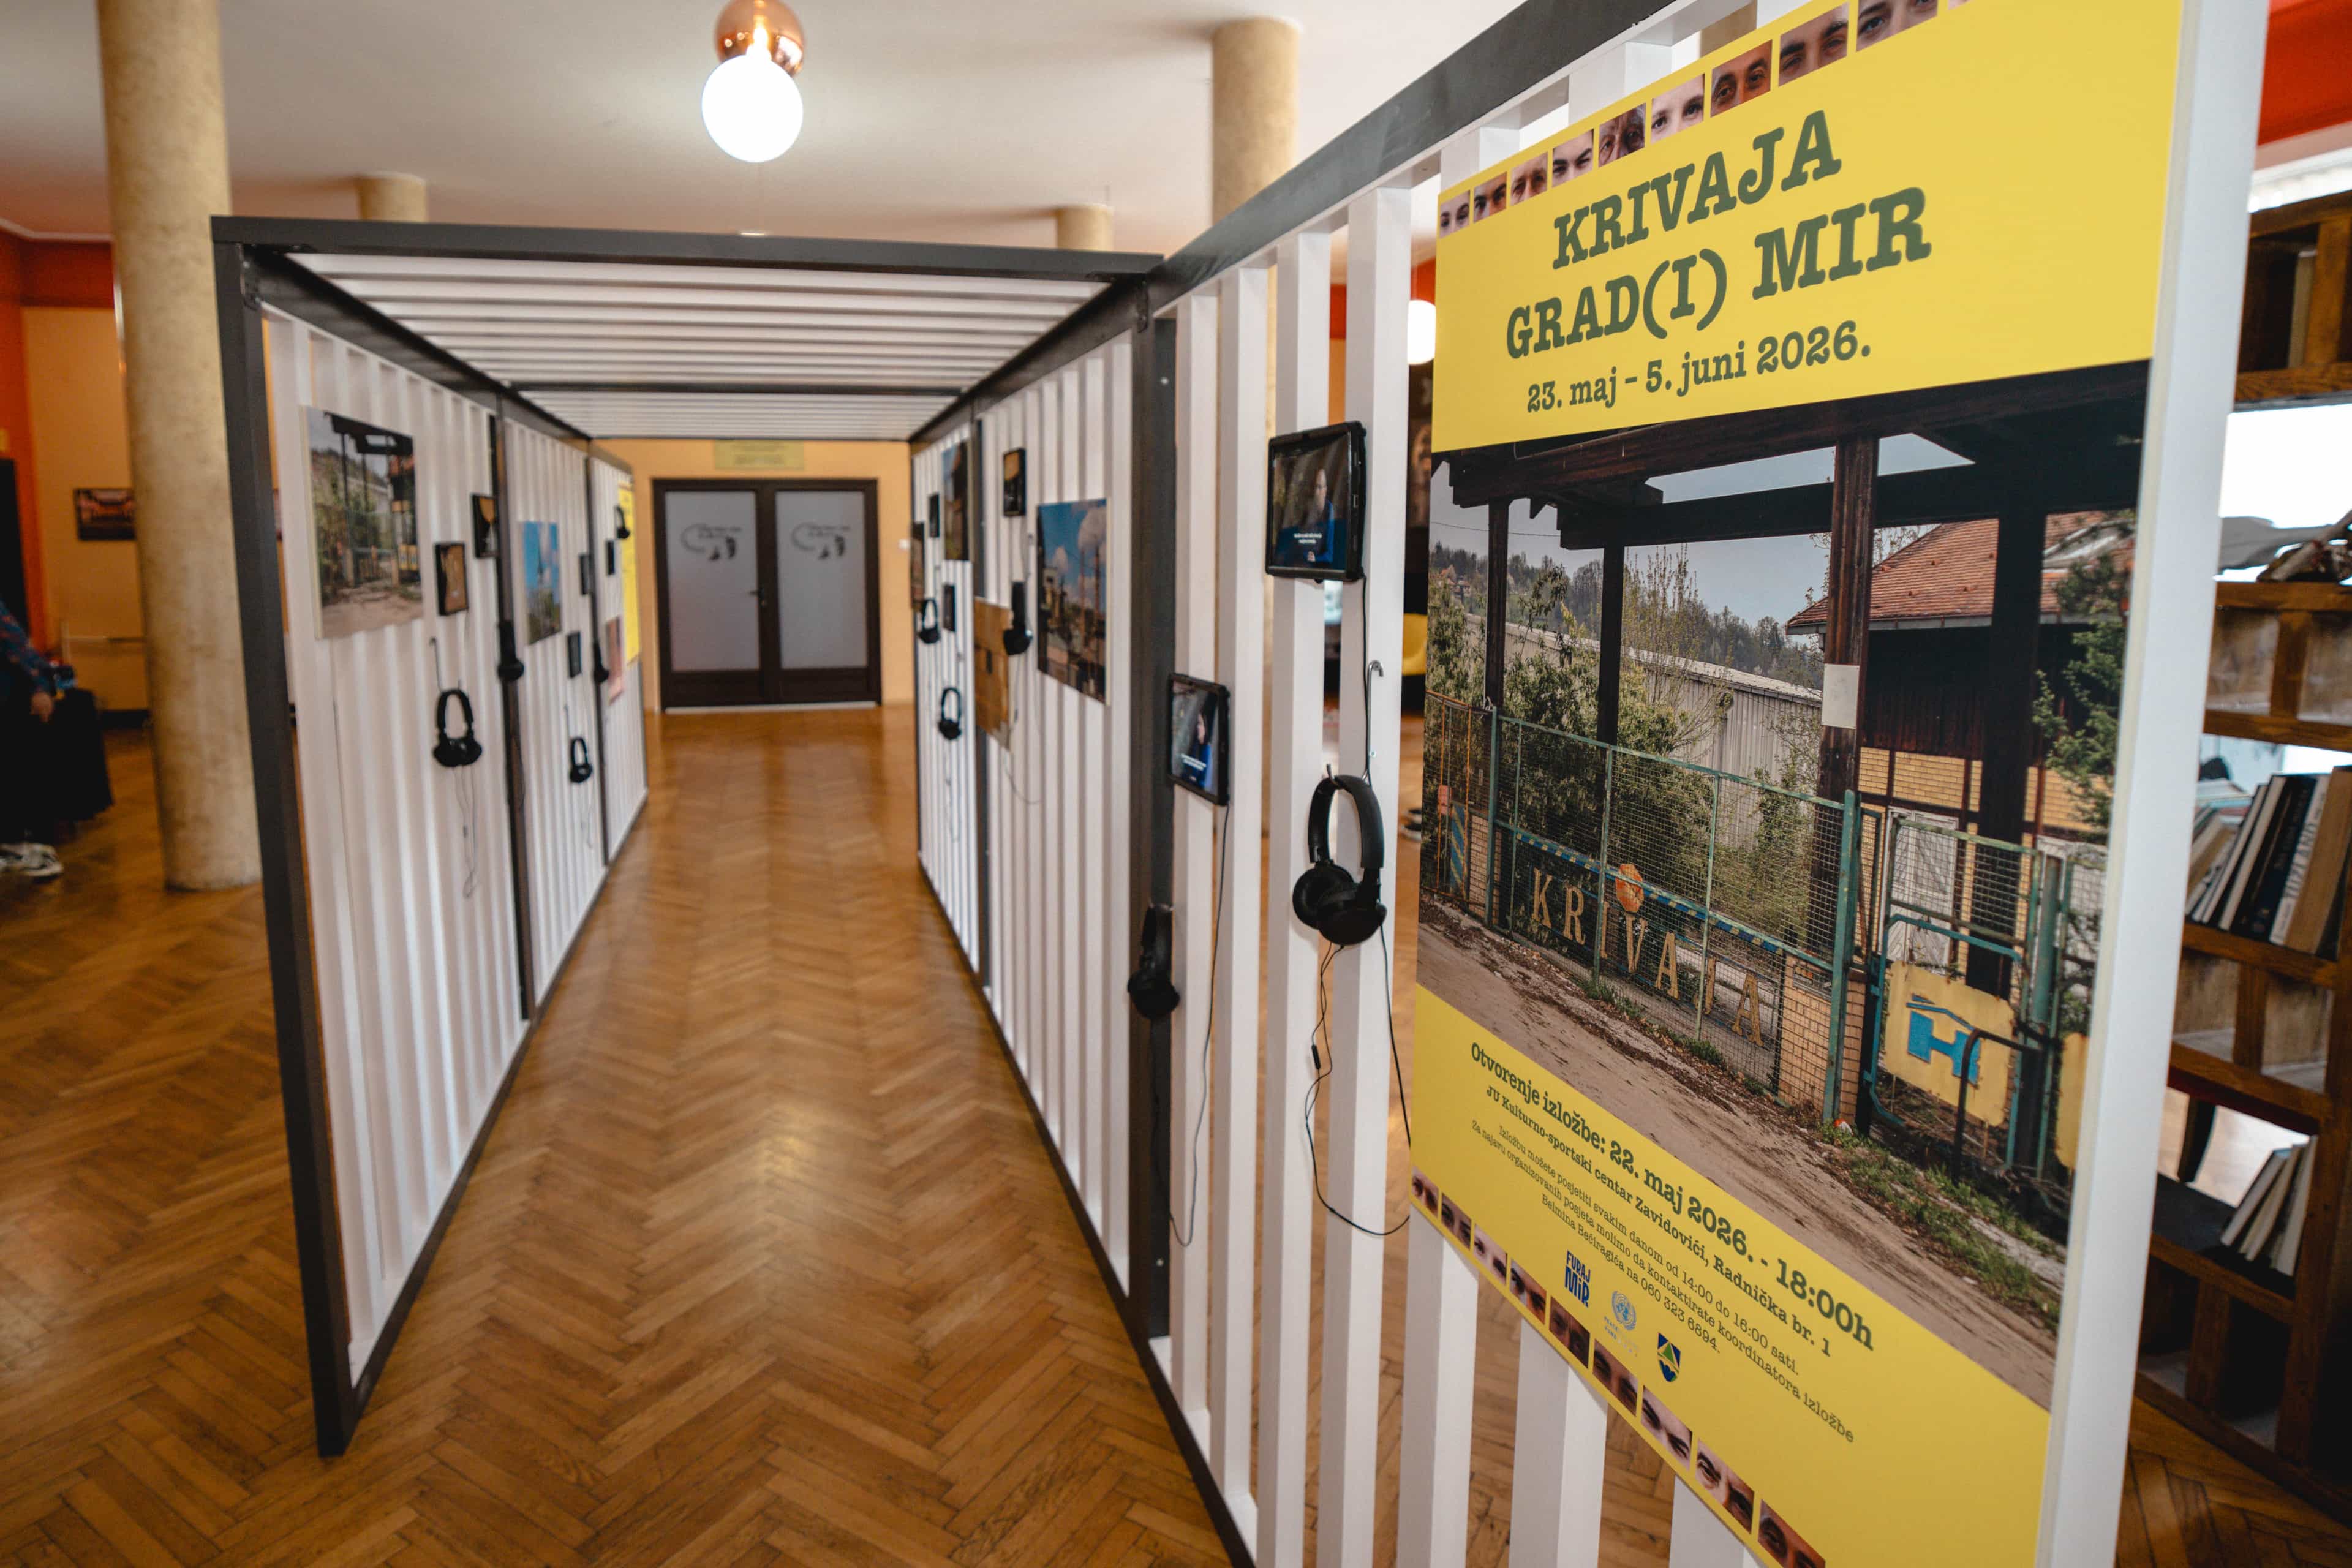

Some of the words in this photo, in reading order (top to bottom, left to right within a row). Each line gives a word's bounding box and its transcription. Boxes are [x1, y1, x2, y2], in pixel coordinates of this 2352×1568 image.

[1506, 248, 1727, 360] GRAD(I)
[1752, 187, 1932, 300] MIR
[1553, 110, 1842, 270] KRIVAJA
[1527, 380, 1562, 413] 23.
[1569, 366, 1617, 409] maj
[1646, 359, 1673, 393] 5.
[1676, 341, 1747, 397] juni
[1757, 320, 1871, 375] 2026.
[1471, 1042, 1540, 1105] Otvorenje
[1543, 1091, 1605, 1154] izložbe:
[1610, 1140, 1639, 1178] 22.
[1643, 1169, 1683, 1215] maj
[1687, 1196, 1753, 1262] 2026.
[1776, 1258, 1874, 1352] 18:00h
[1472, 1119, 1480, 1135] Za
[1482, 1130, 1506, 1156] najavu
[1507, 1151, 1562, 1201] organizovanih
[1564, 1197, 1595, 1227] posjeta
[1596, 1223, 1631, 1257] molimo
[1633, 1253, 1645, 1270] da
[1647, 1262, 1716, 1327] kontaktirate
[1717, 1321, 1801, 1400] koordinatora
[1803, 1393, 1854, 1443] izložbe
[1487, 1085, 1500, 1102] JU
[1502, 1096, 1592, 1174] Kulturno-sportski
[1595, 1169, 1633, 1204] centar
[1713, 1254, 1787, 1324] Radnička
[1792, 1314, 1815, 1346] br.
[1822, 1338, 1830, 1358] 1
[1499, 1125, 1526, 1155] Izložbu
[1528, 1149, 1556, 1178] možete
[1558, 1174, 1592, 1207] posjetiti
[1594, 1203, 1627, 1236] svakim
[1629, 1231, 1663, 1265] danom
[1666, 1261, 1678, 1278] od
[1682, 1271, 1713, 1304] 14:00
[1716, 1300, 1729, 1318] do
[1734, 1313, 1768, 1349] 16:00
[1771, 1346, 1799, 1376] sati.
[1542, 1193, 1576, 1231] Belmina
[1627, 1267, 1639, 1284] na
[1641, 1278, 1661, 1302] 060
[1664, 1295, 1685, 1322] 323
[1687, 1317, 1721, 1354] 6894.
[1566, 1250, 1591, 1283] FURAJ
